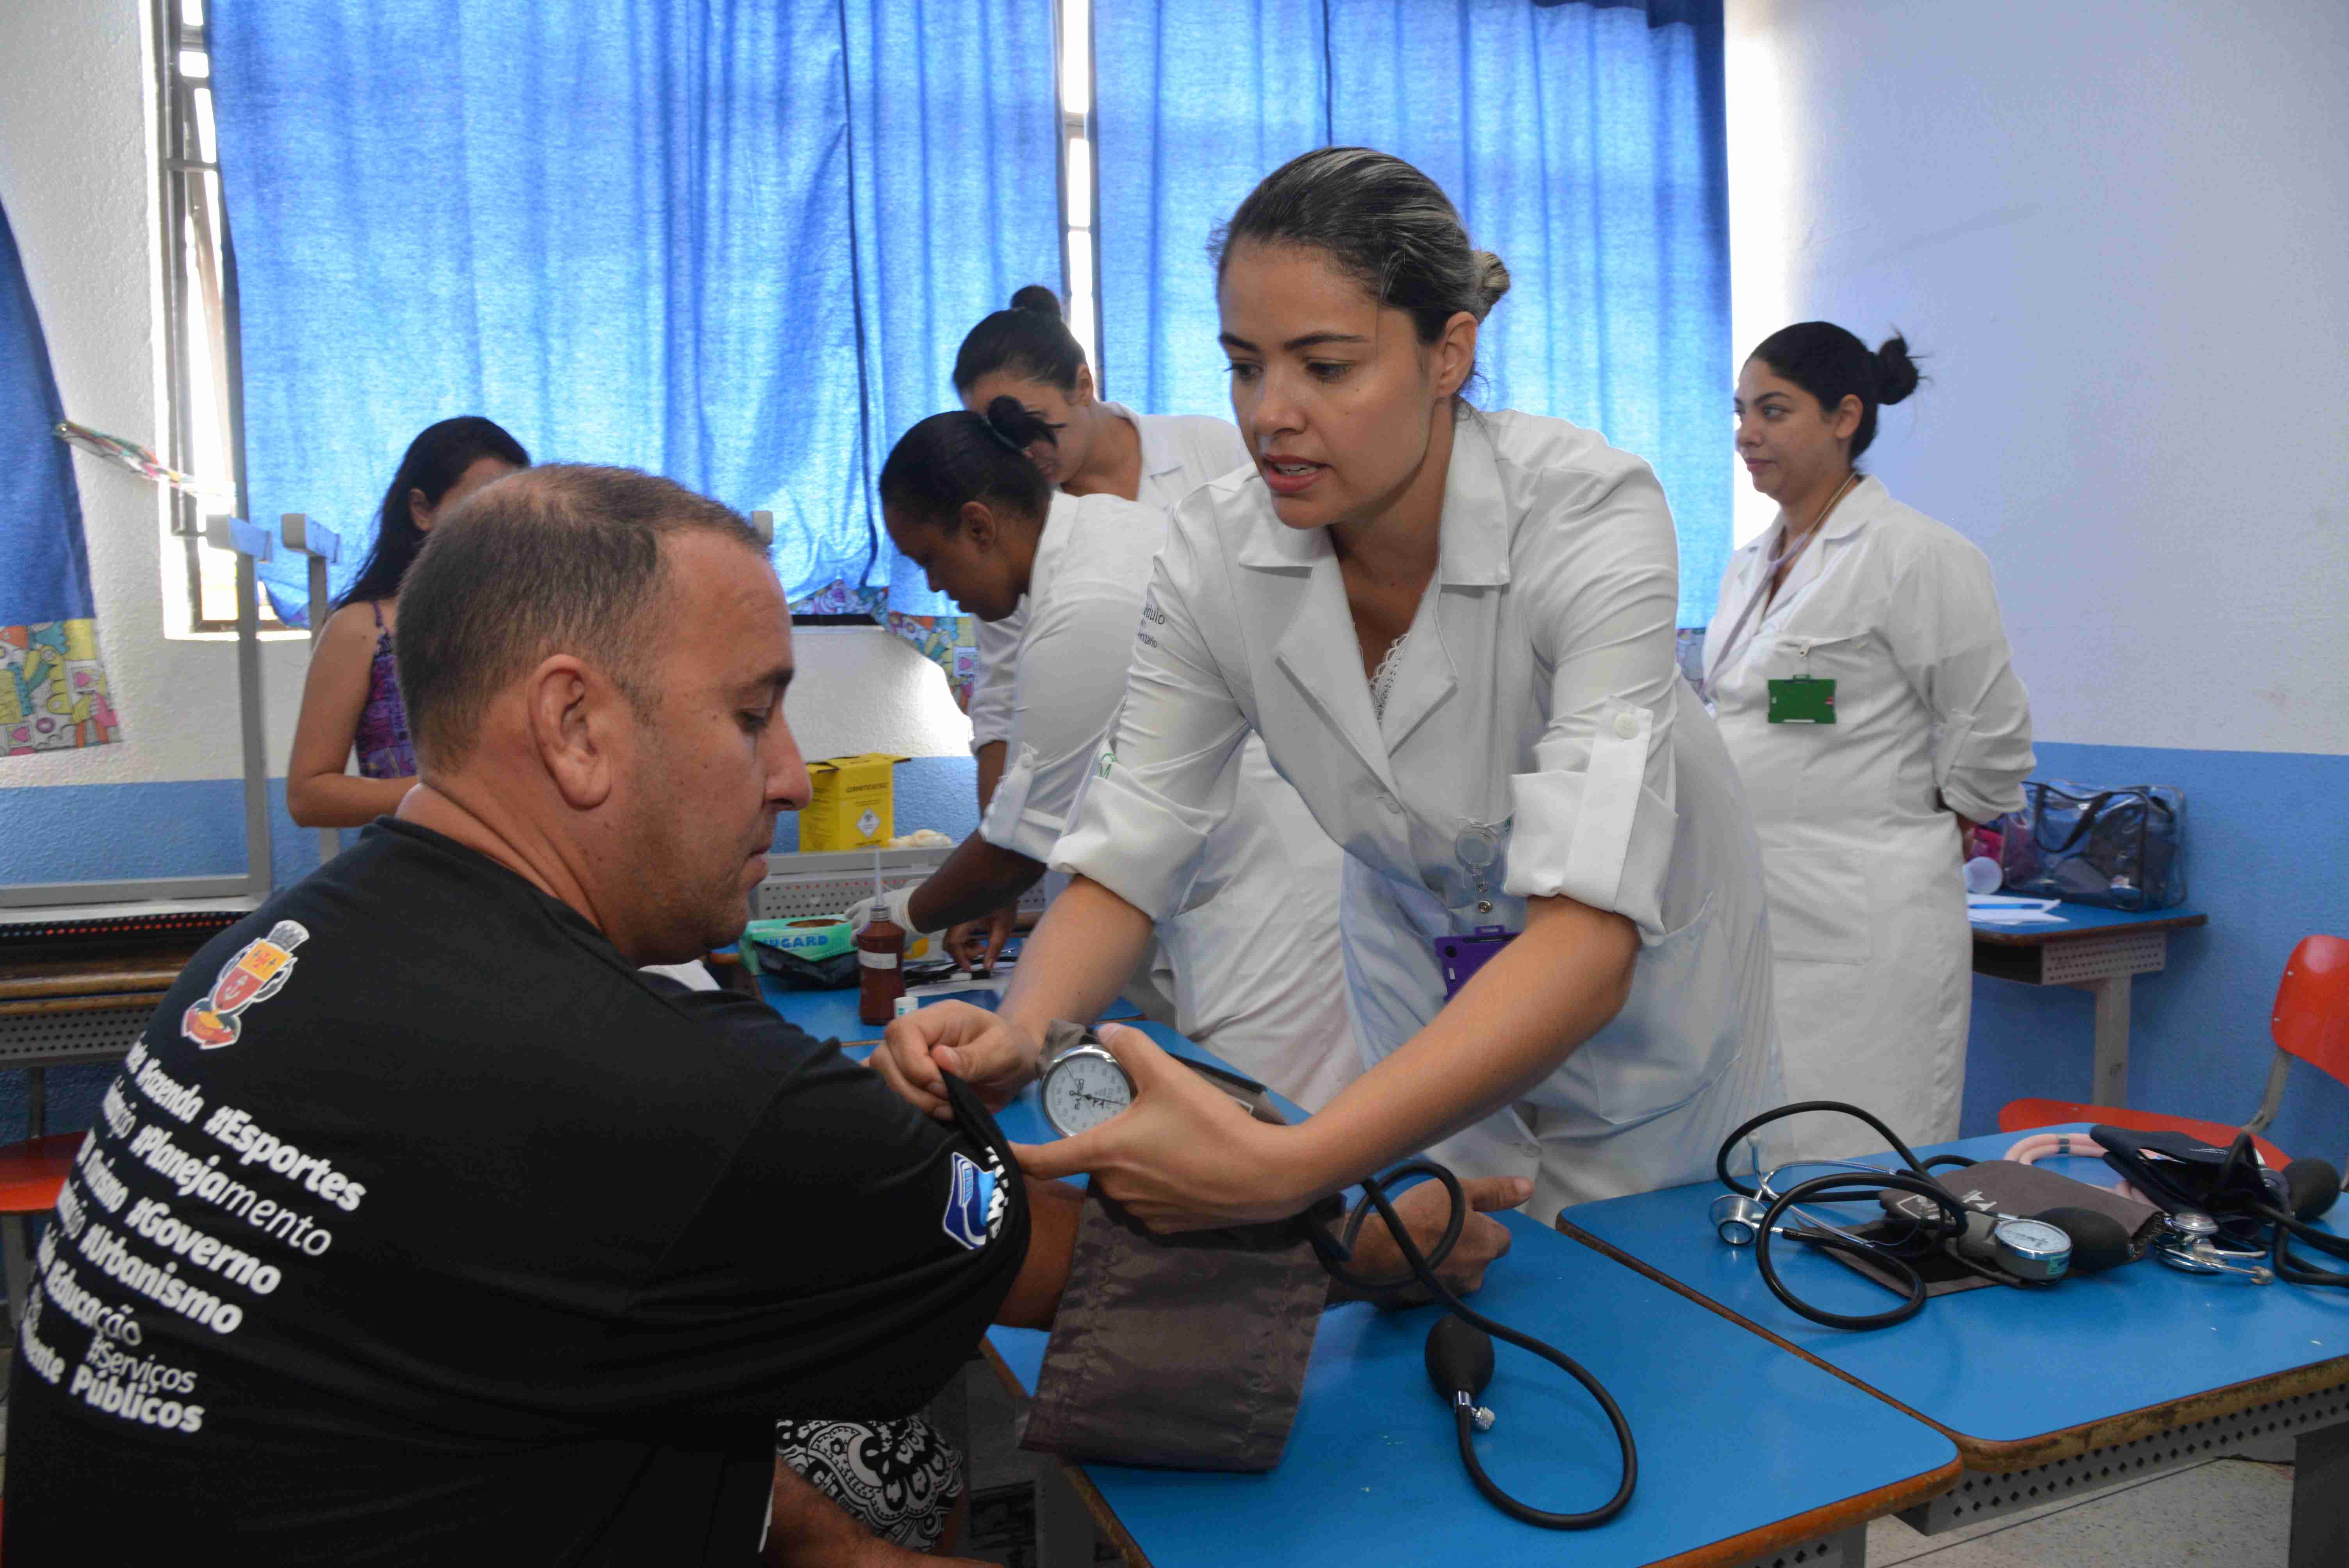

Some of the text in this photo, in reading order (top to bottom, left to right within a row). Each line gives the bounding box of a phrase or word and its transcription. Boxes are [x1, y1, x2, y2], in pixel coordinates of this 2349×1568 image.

[129, 1124, 331, 1256] #Planejamento
[202, 1106, 367, 1212] #Esportes
[78, 1223, 242, 1333] #Urbanismo
[123, 1197, 281, 1295] #Governo
[46, 1258, 142, 1346] #Educação
[70, 1365, 205, 1433] Públicos
[86, 1335, 197, 1394] #Serviços
